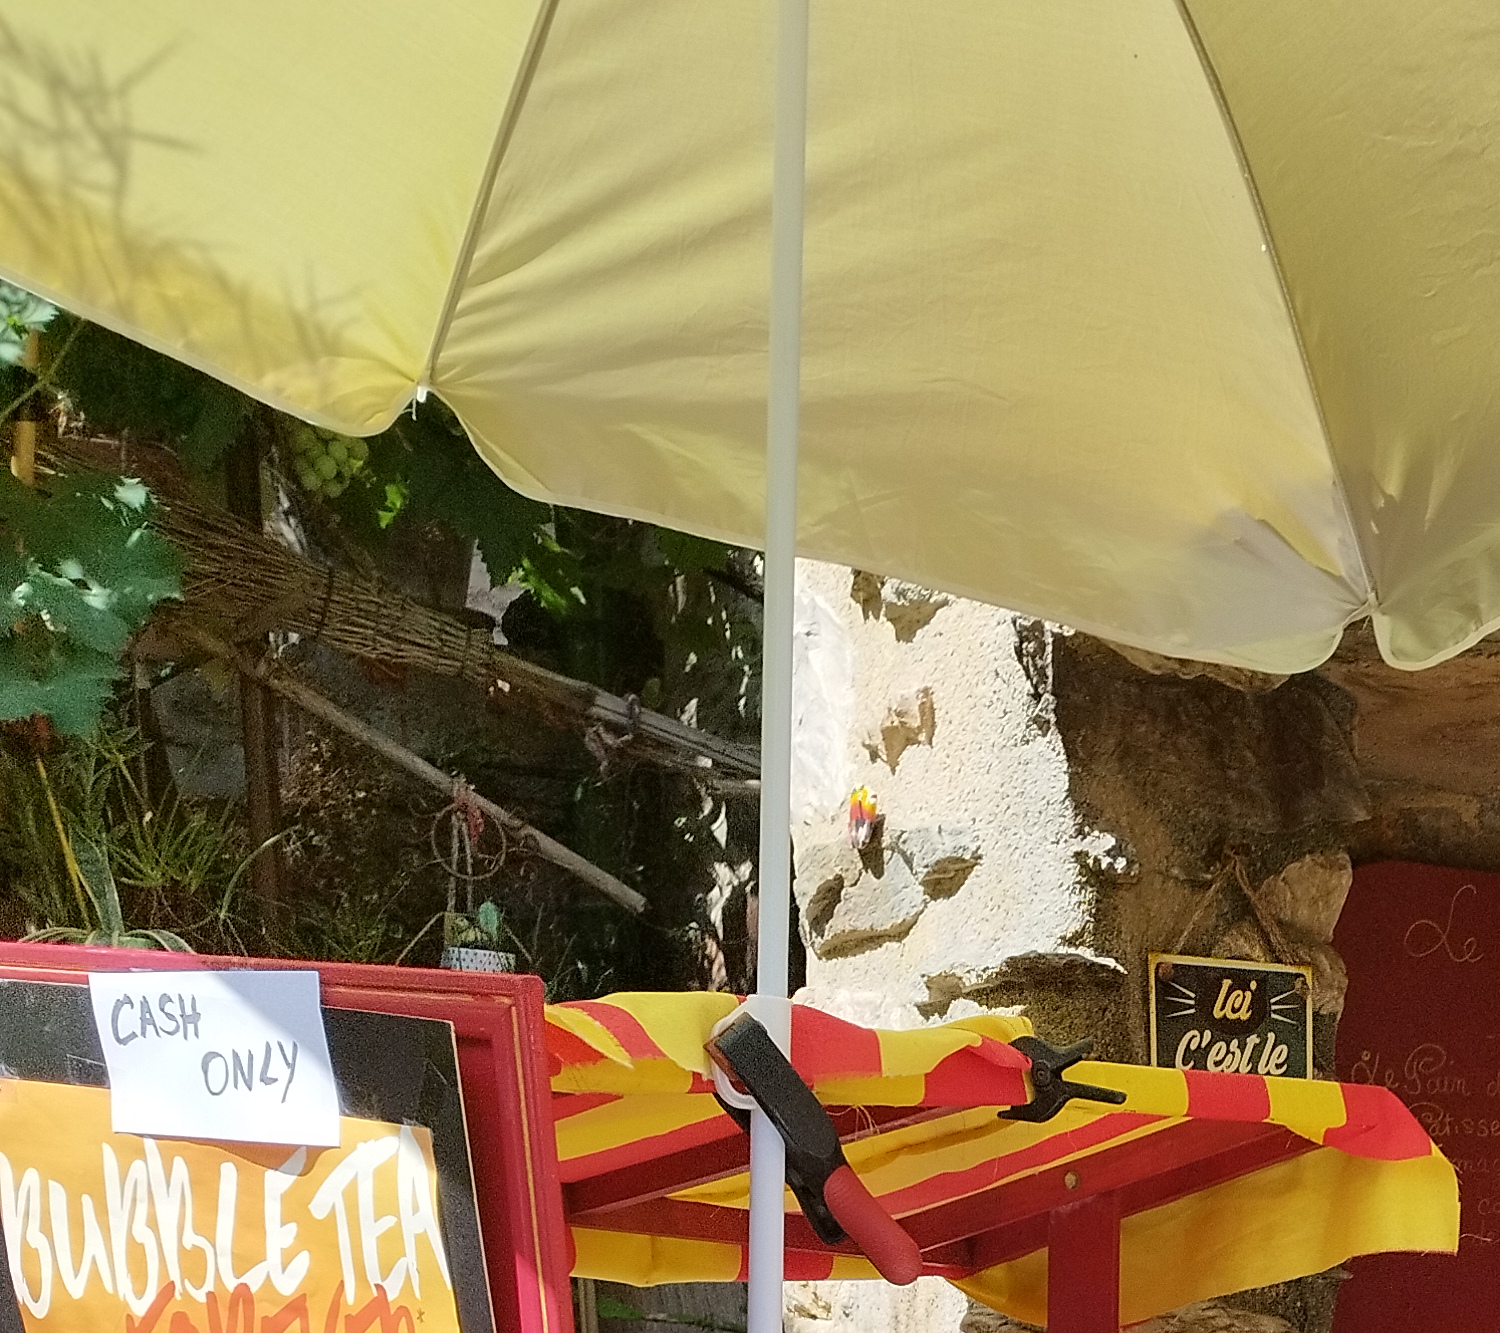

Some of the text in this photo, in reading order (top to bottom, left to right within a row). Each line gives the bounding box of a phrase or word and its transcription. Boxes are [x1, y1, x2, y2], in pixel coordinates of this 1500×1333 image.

[1404, 885, 1485, 963] Le
[110, 993, 201, 1046] CASH
[1213, 979, 1257, 1020] Ici
[201, 1040, 299, 1103] ONLY
[1175, 1030, 1288, 1075] C'est le
[1404, 1043, 1472, 1097] Pain
[0, 1125, 452, 1319] BUBBLE TEA
